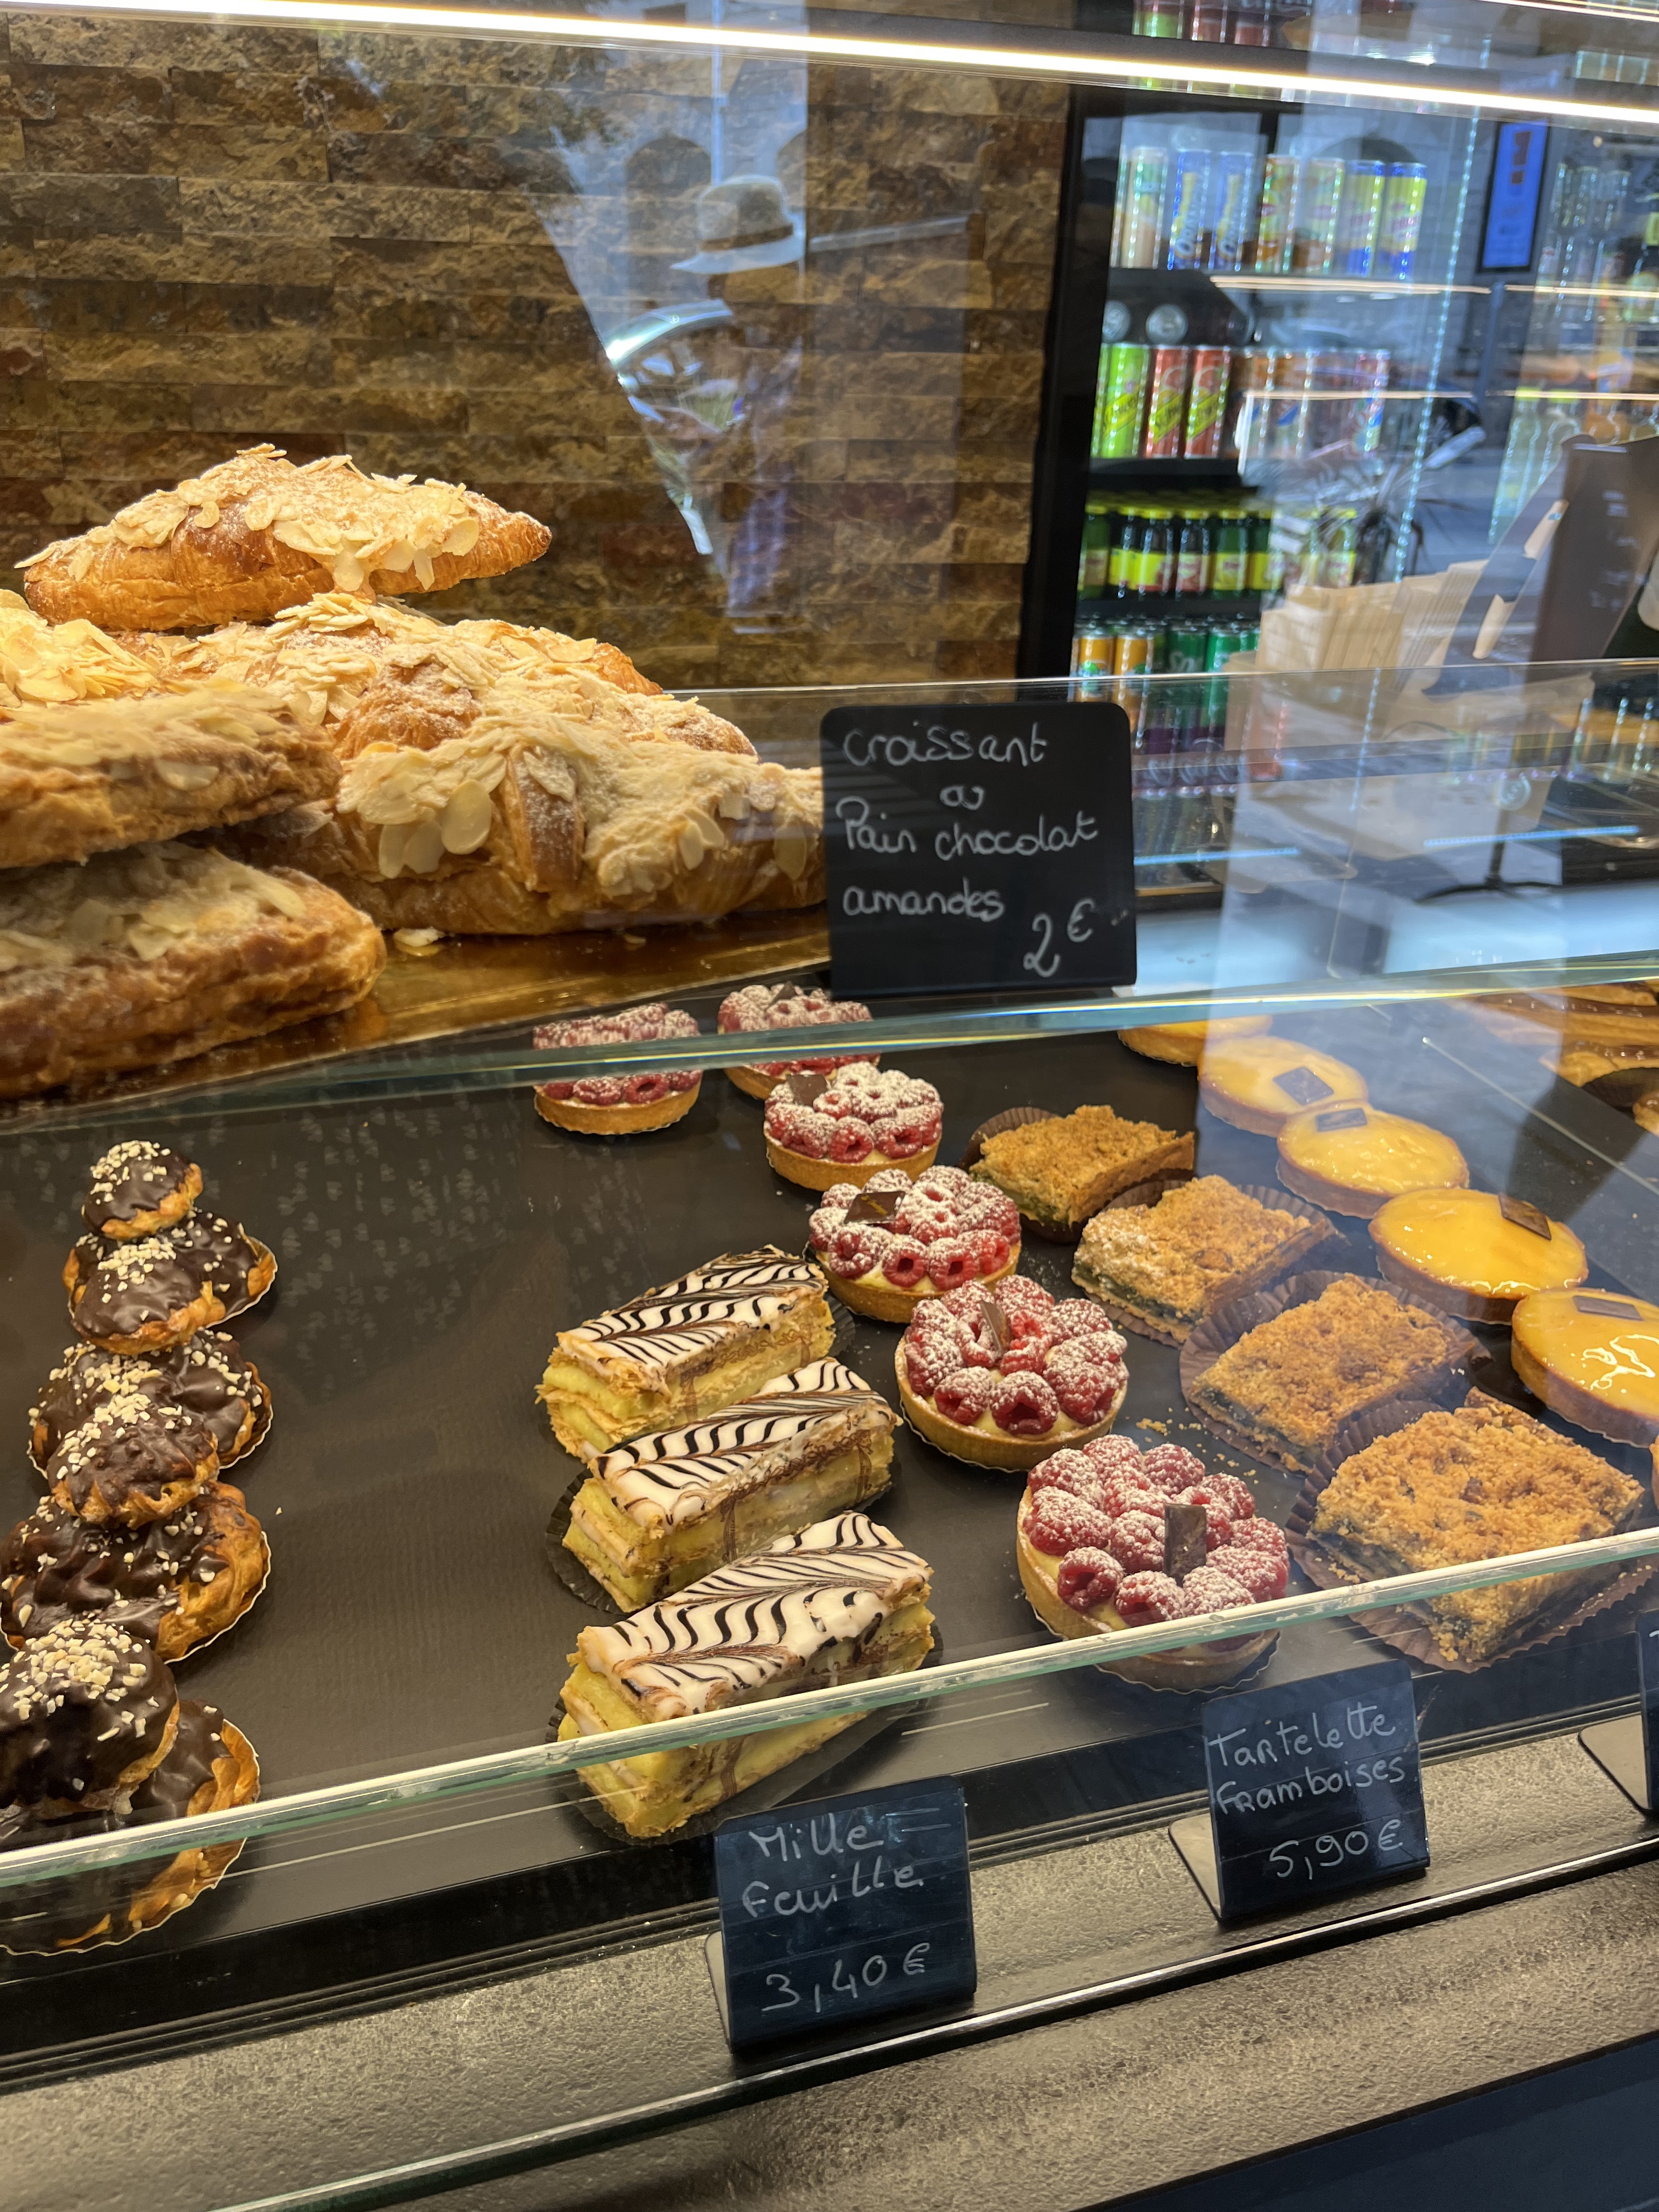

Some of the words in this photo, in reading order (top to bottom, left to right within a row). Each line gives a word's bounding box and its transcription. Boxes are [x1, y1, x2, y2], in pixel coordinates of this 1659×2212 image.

[836, 796, 918, 853] Pain
[934, 810, 1099, 861] chocolat
[843, 877, 1005, 922] amandes
[749, 1813, 884, 1861] Mille
